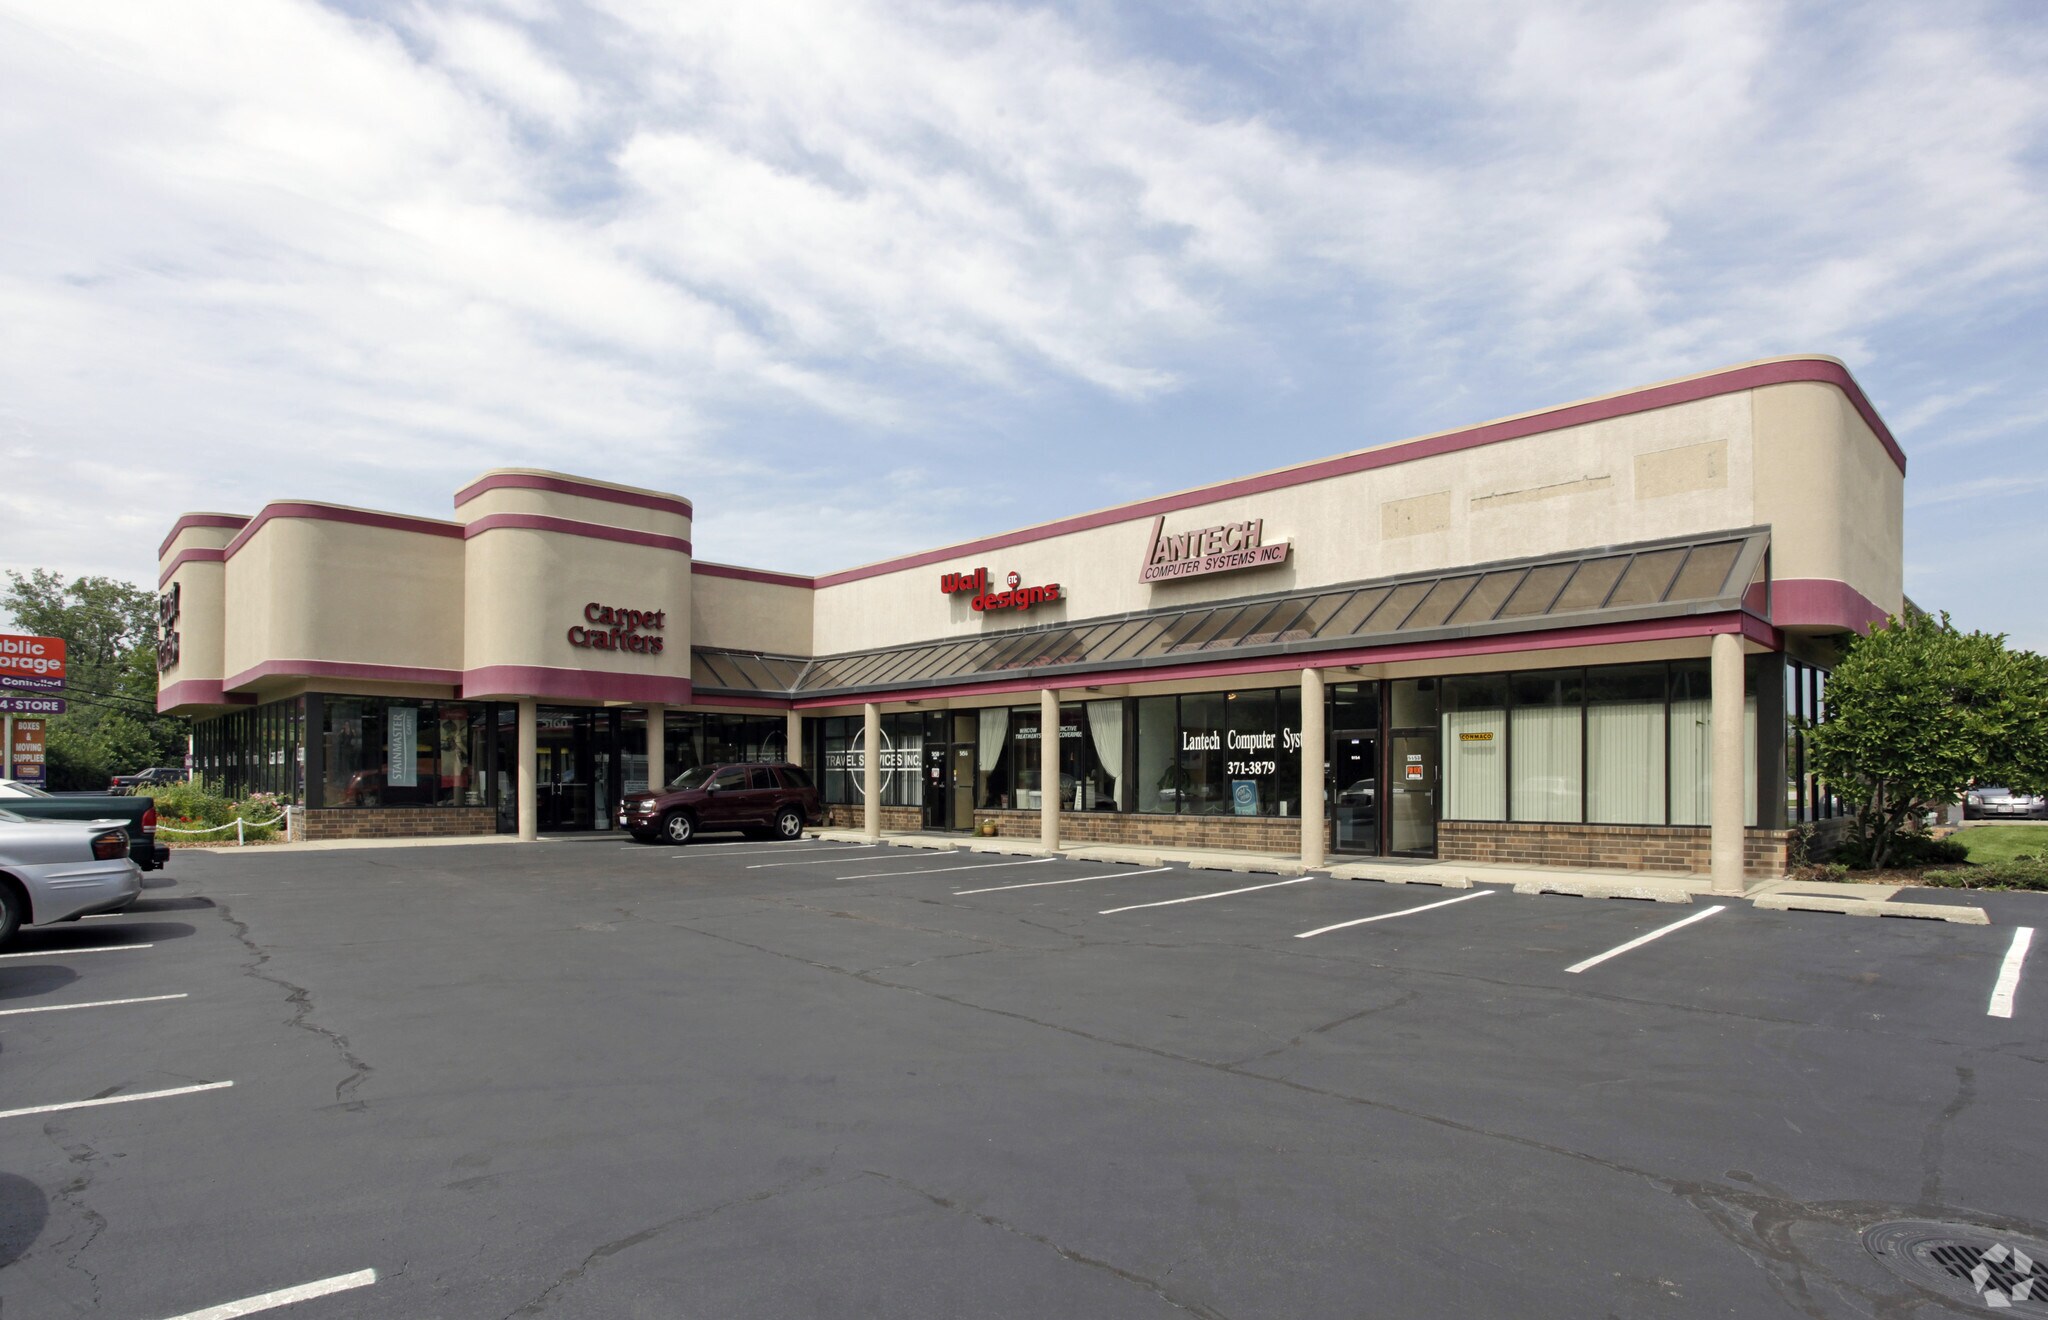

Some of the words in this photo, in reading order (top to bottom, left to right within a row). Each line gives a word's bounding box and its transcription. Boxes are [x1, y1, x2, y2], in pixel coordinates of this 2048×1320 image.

[1148, 515, 1263, 564] LANTECH
[1145, 560, 1200, 580] COMPUTER
[1204, 551, 1256, 571] SYSTEMS
[1260, 546, 1282, 562] INC.
[1008, 575, 1018, 585] ETC
[971, 581, 1061, 611] designs
[584, 602, 666, 633] Carpet
[567, 625, 664, 655] Crafters
[18, 722, 40, 730] BOXES
[26, 732, 32, 741] &
[1183, 730, 1220, 751] Lantech
[1227, 729, 1276, 754] Computer
[16, 743, 42, 751] MOVING
[392, 713, 404, 780] STAINMASTER
[13, 754, 45, 763] SUPPLIES
[905, 754, 922, 767] INC.
[1227, 761, 1276, 775] 371-3879
